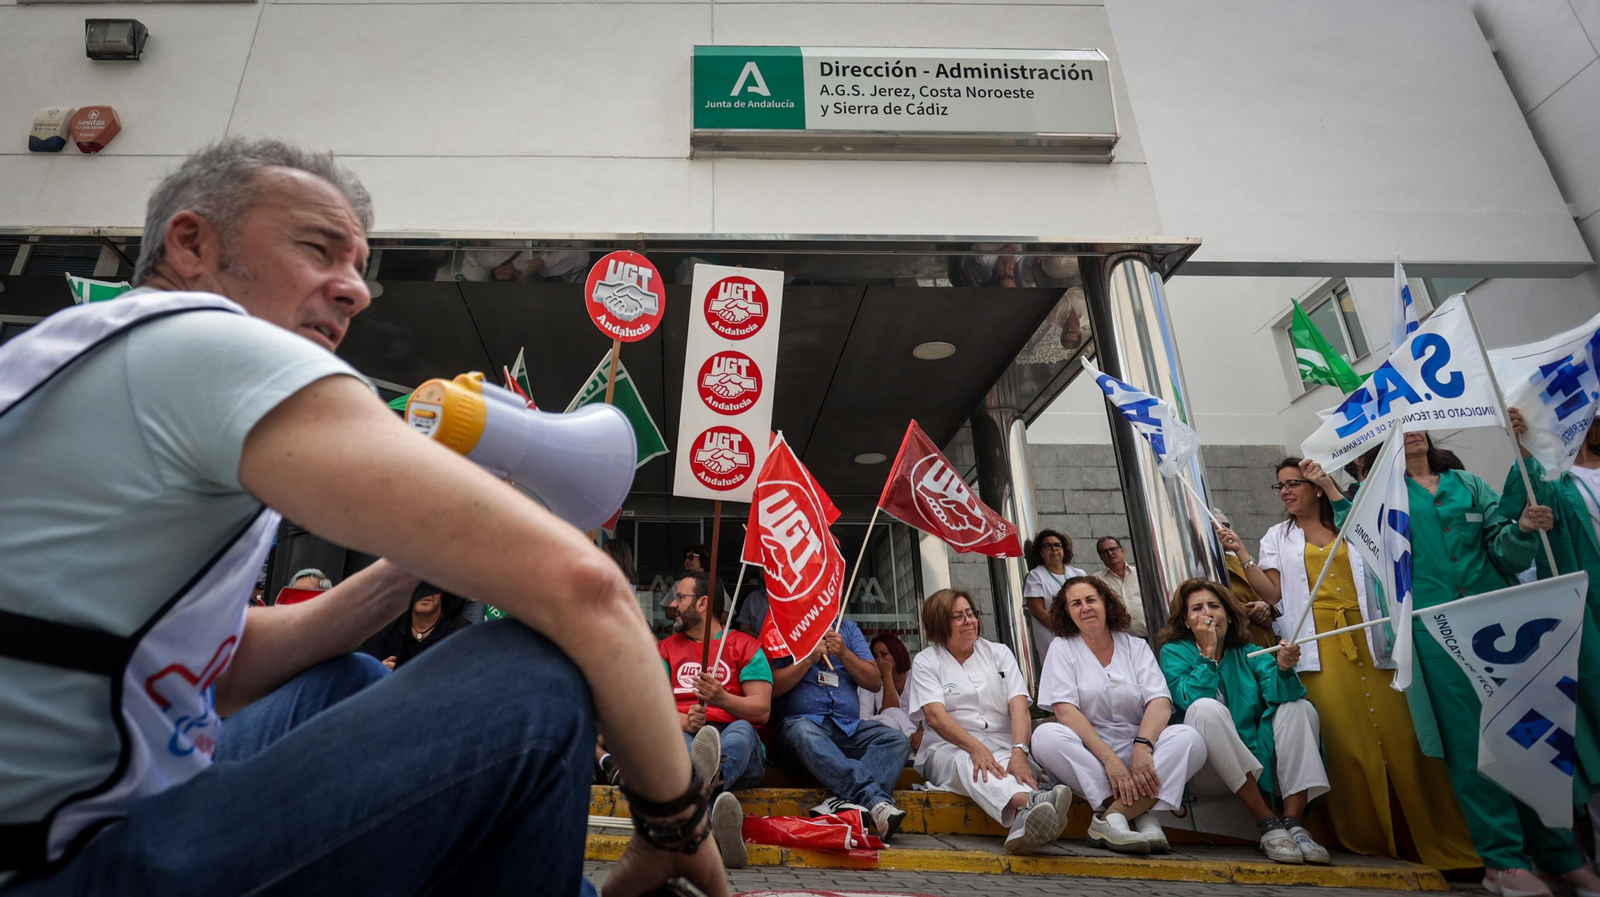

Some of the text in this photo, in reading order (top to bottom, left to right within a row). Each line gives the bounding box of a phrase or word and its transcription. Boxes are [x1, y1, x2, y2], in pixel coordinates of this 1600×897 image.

[820, 60, 917, 78] Dirección
[935, 62, 1093, 81] Administración
[820, 84, 1035, 99] A.G.S. Jerez, Costa Noroeste
[704, 99, 795, 108] Junta de Andalucía
[820, 101, 949, 117] y Sierra de Cádiz
[604, 259, 653, 291] UGT
[718, 281, 756, 301] UGT
[711, 356, 750, 377] UGT
[703, 431, 742, 452] UGT
[758, 488, 822, 575] UGT
[1433, 613, 1465, 662] SINDICATO
[1464, 662, 1478, 674] DE
